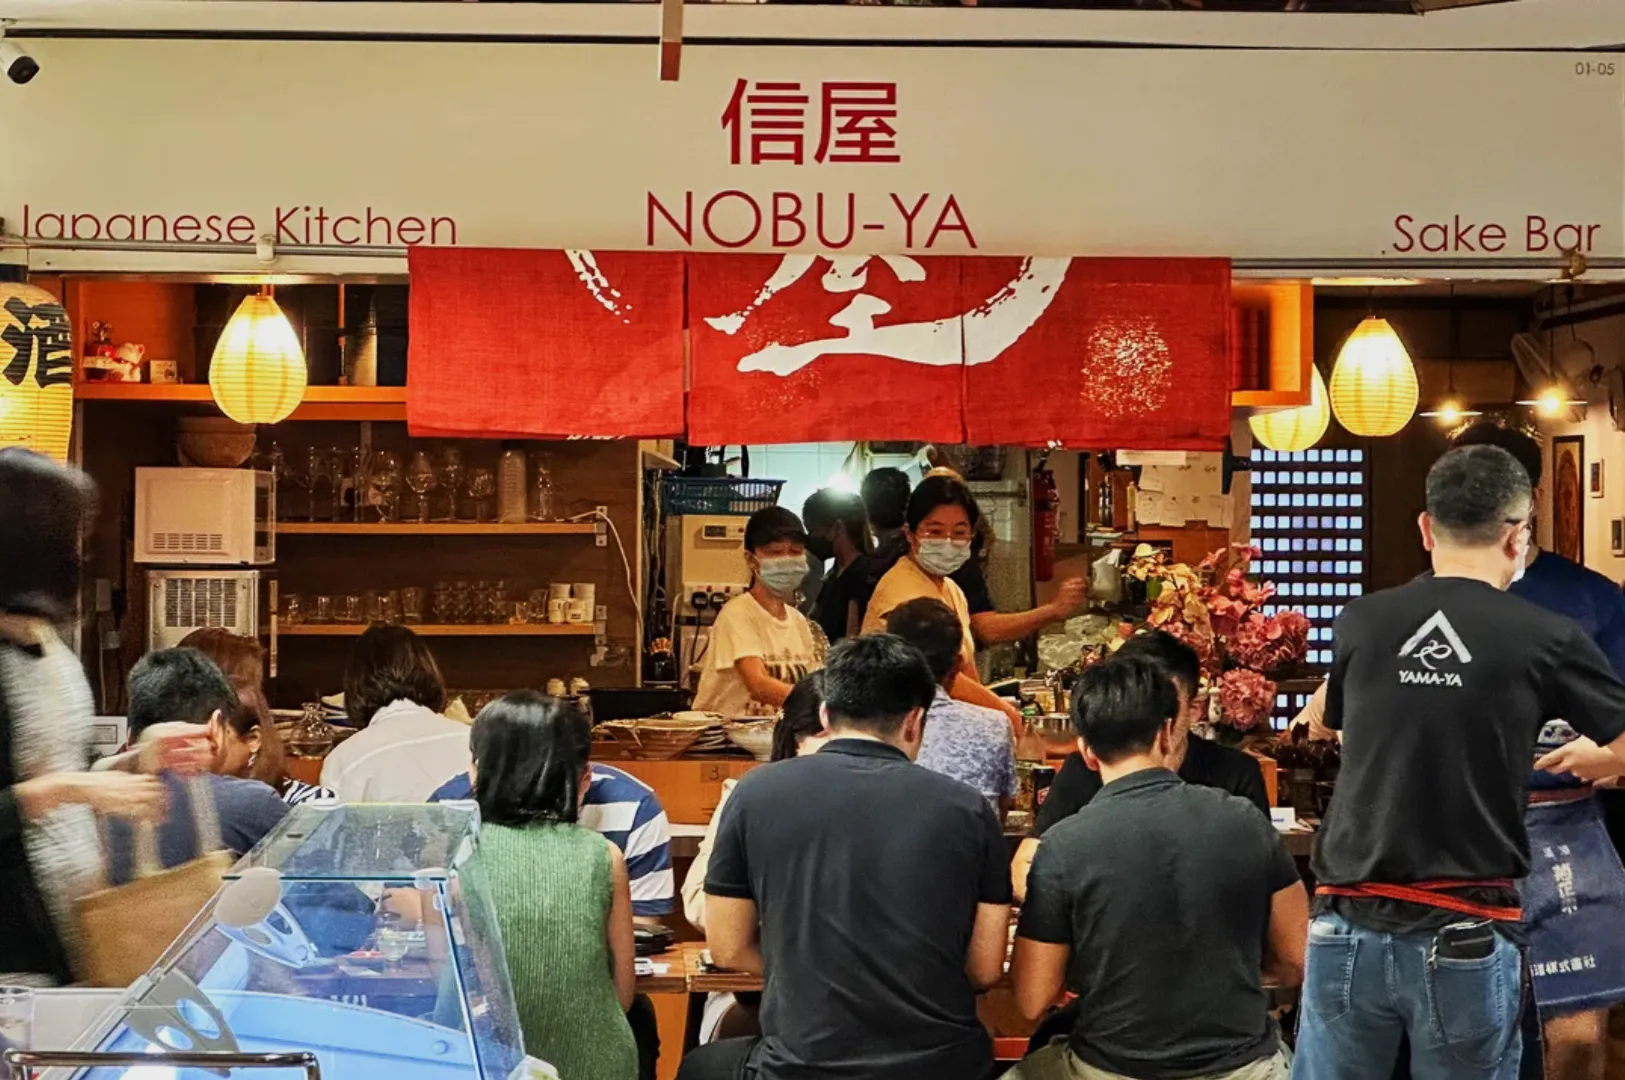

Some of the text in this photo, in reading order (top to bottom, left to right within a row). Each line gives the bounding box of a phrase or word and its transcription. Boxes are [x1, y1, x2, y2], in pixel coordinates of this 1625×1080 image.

[1575, 61, 1616, 77] 01-05
[721, 78, 901, 165] 信屋
[275, 206, 457, 245] Kitchen
[647, 190, 978, 249] NOBU-YA
[1393, 214, 1602, 252] Sake Bar
[1398, 669, 1463, 687] YAMA-YA
